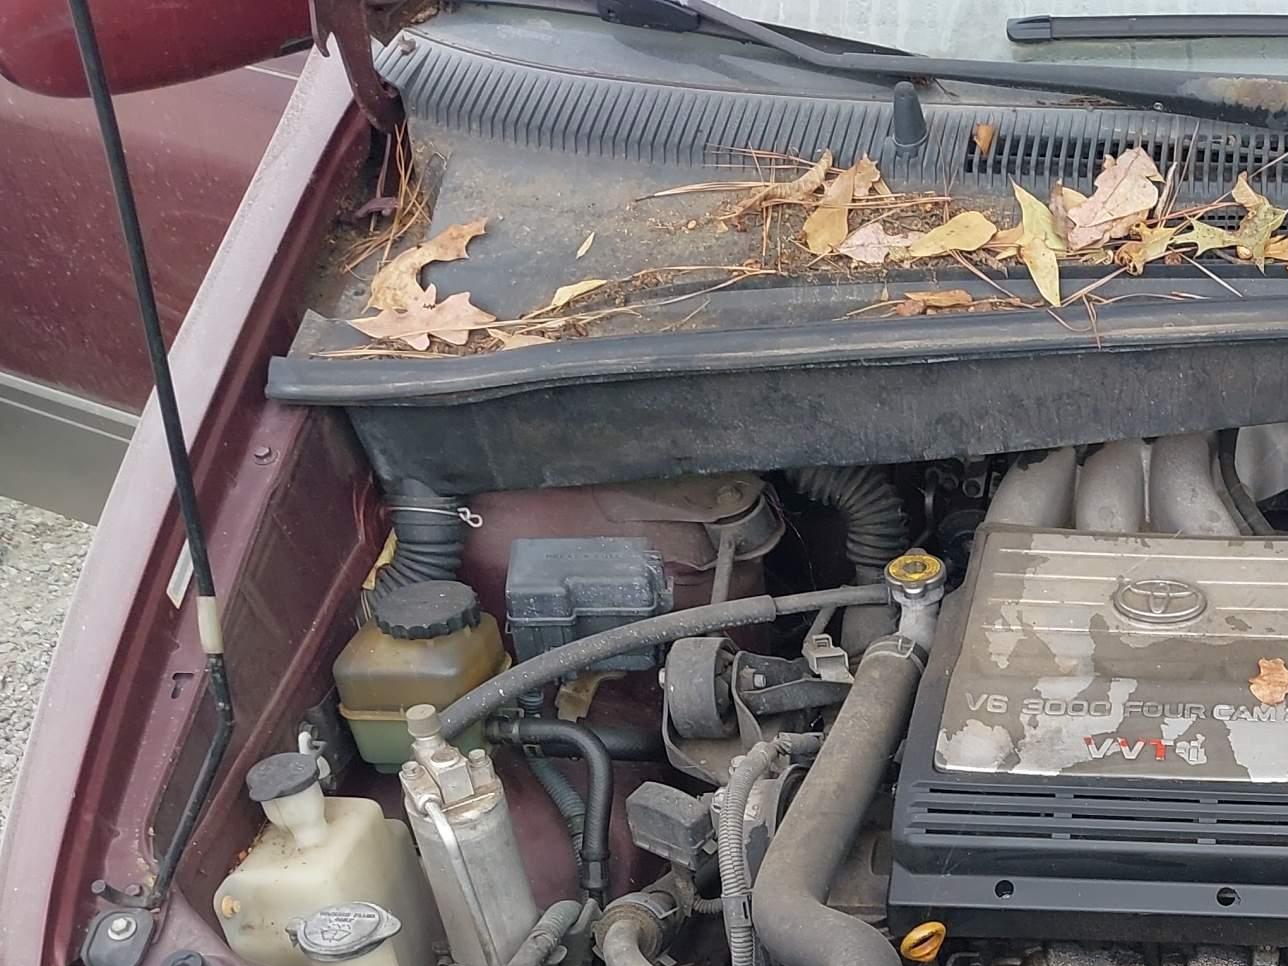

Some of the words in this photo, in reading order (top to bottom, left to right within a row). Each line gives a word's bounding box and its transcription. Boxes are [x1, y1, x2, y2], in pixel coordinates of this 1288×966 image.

[965, 692, 1009, 714] V6
[1021, 698, 1111, 718] 3000
[1124, 700, 1206, 719] FOUR
[1212, 703, 1277, 722] CAM
